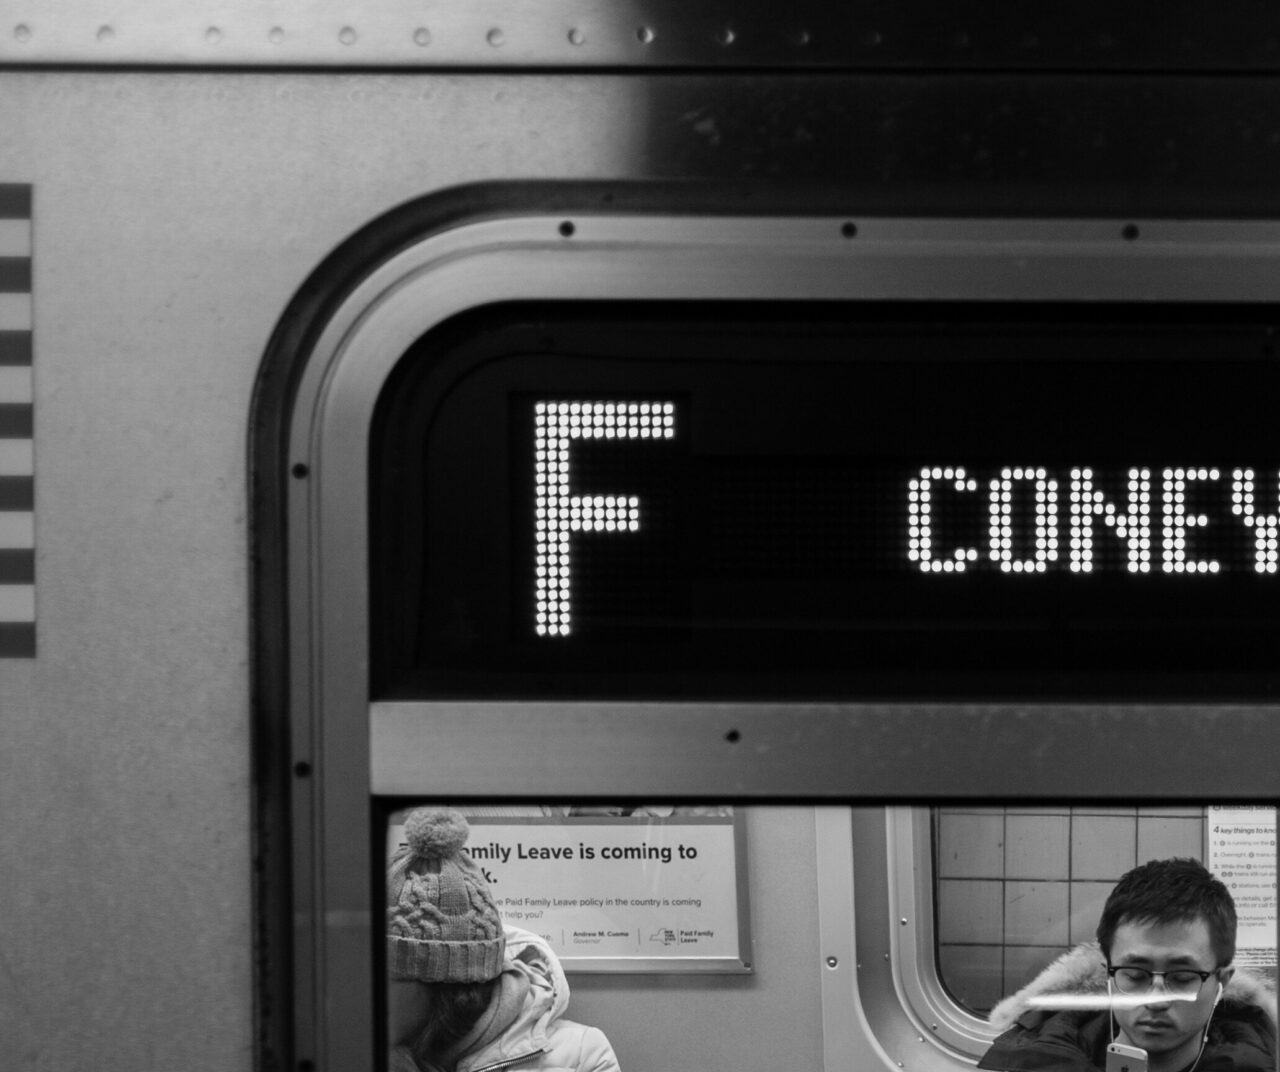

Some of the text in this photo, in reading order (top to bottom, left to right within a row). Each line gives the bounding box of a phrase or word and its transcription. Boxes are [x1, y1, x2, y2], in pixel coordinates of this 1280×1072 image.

[535, 403, 674, 636] F
[1213, 825, 1220, 834] 4
[1220, 828, 1232, 836] key
[1233, 827, 1255, 836] things
[517, 843, 573, 859] Leave
[579, 843, 595, 859] is
[601, 843, 671, 863] coming
[678, 844, 698, 859] to
[505, 897, 523, 906] Paid
[524, 897, 551, 908] Family
[553, 898, 577, 906] Leave
[579, 898, 604, 908] policy
[605, 898, 613, 906] in
[615, 898, 628, 906] the
[630, 898, 661, 908] country
[663, 898, 669, 906] is
[671, 898, 701, 908] coming
[505, 911, 523, 921] help
[524, 911, 543, 921] you?
